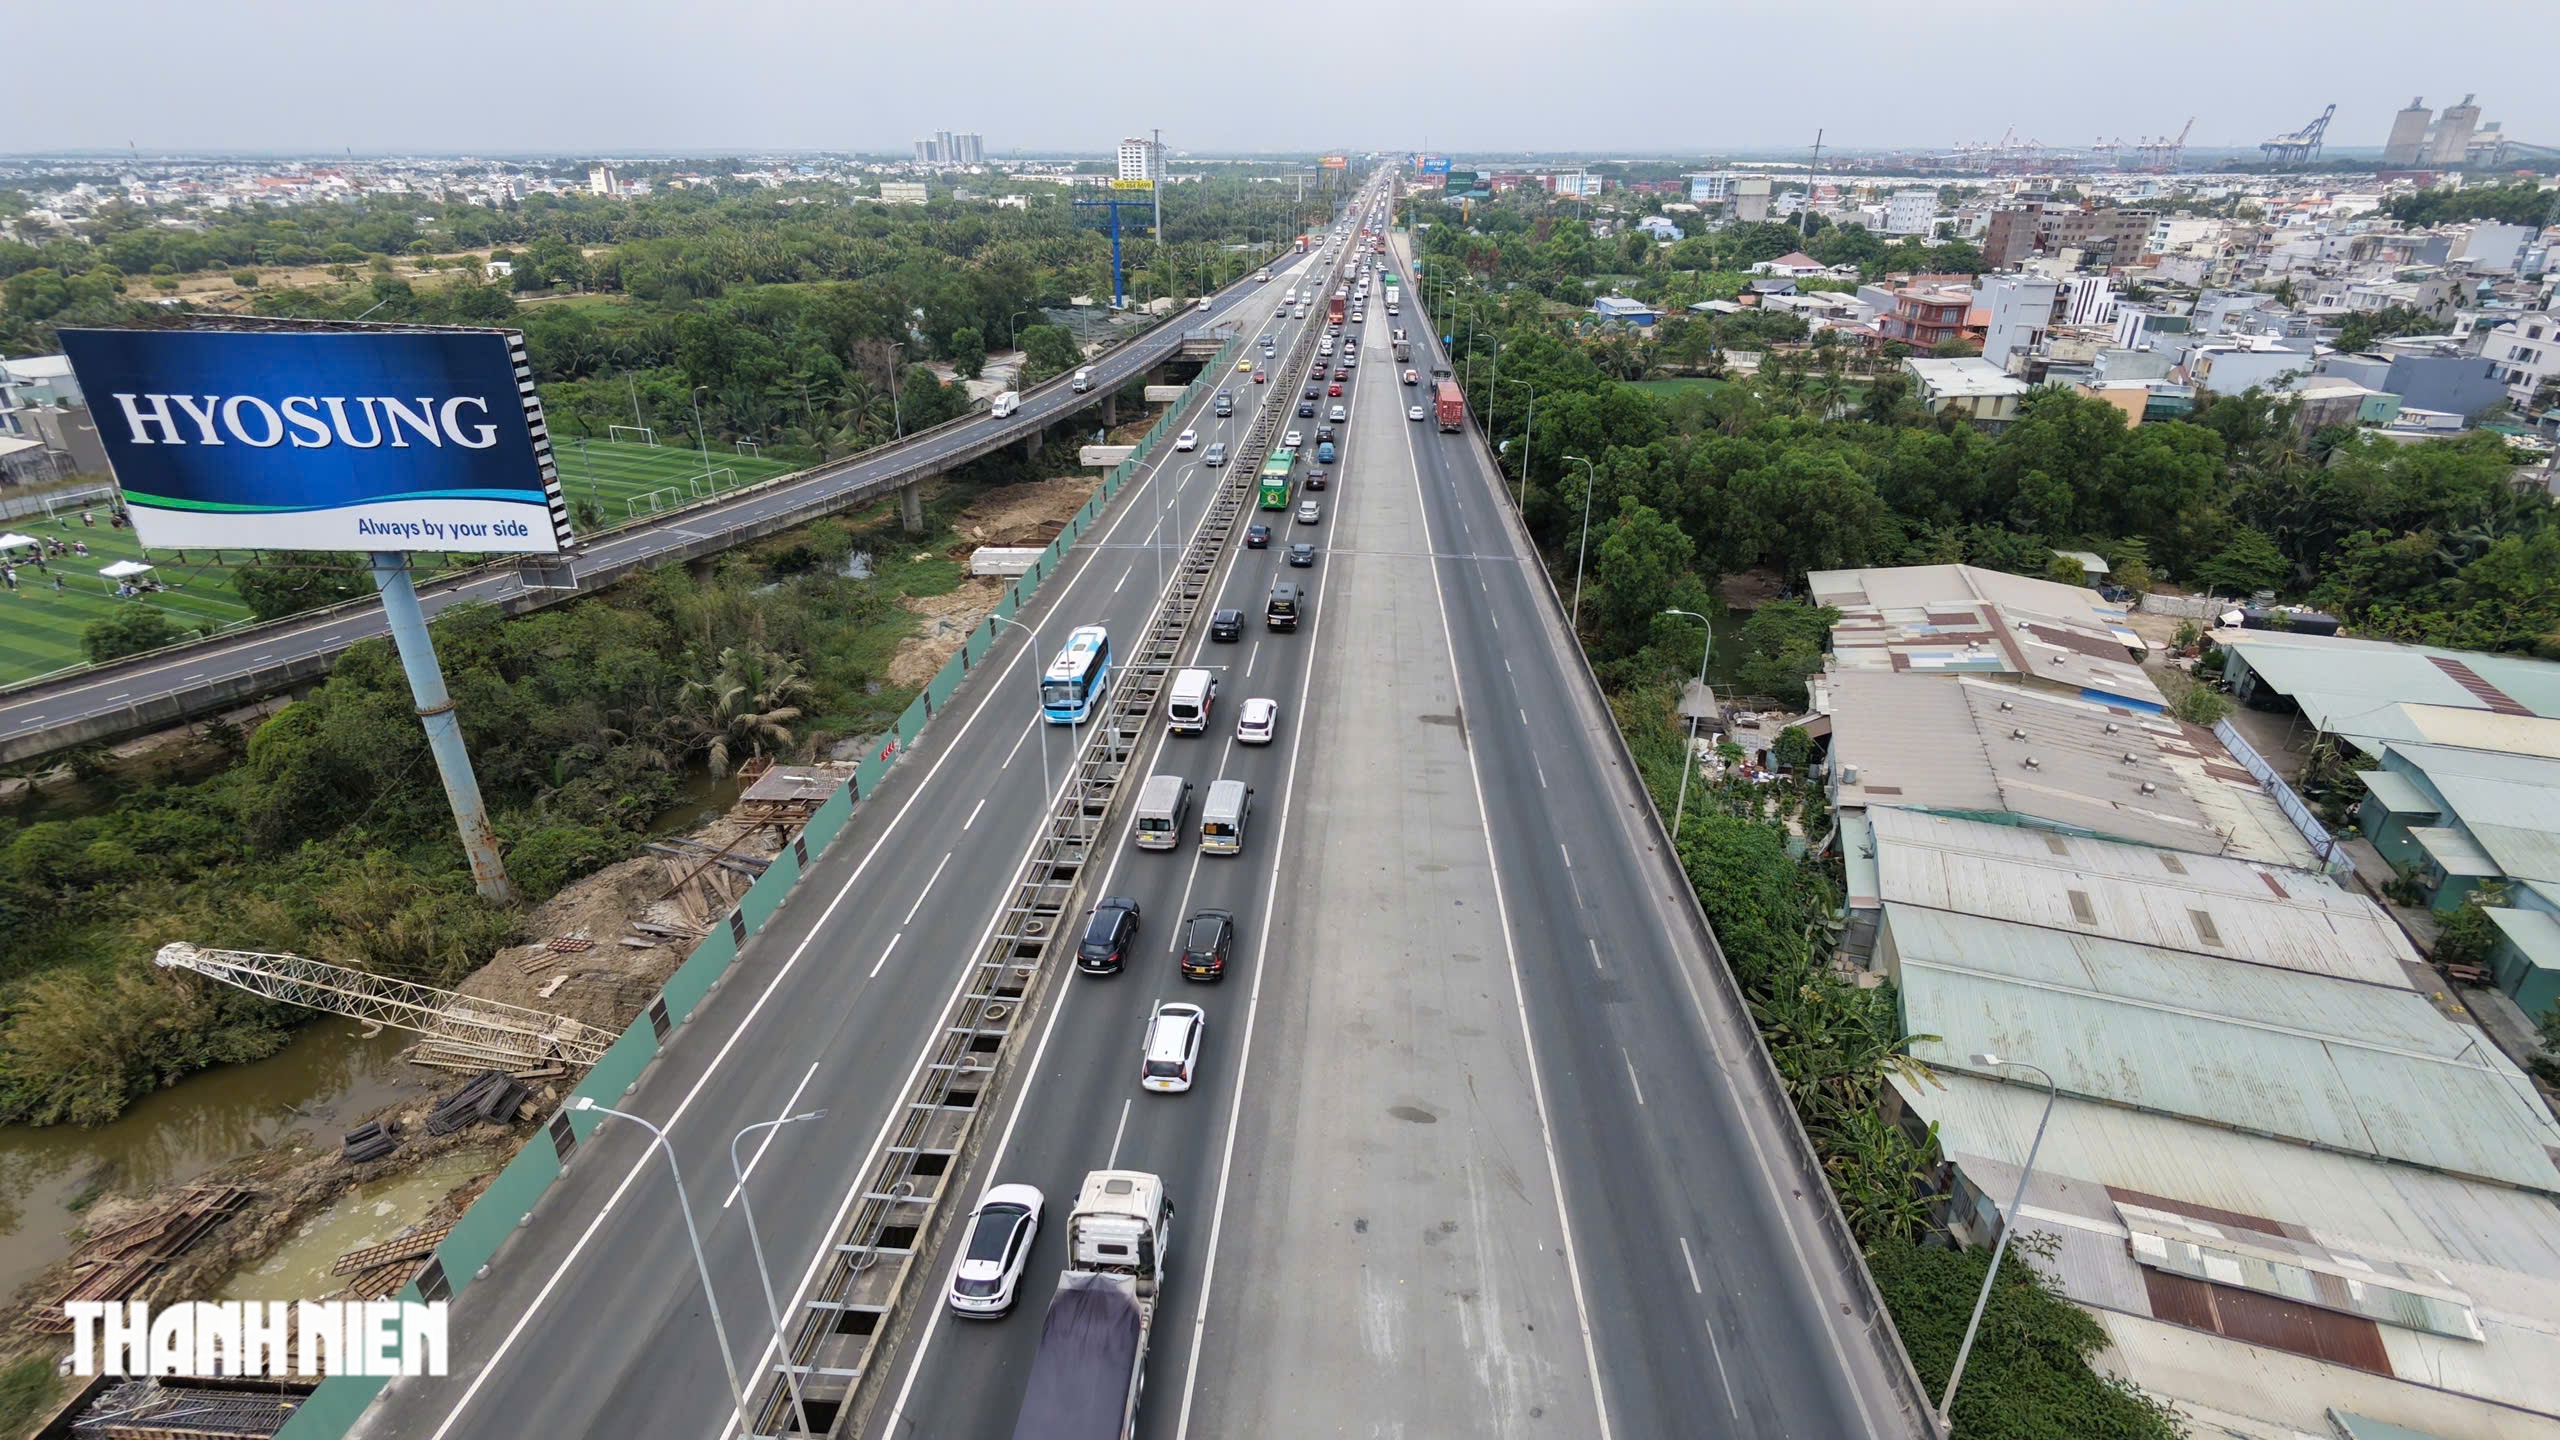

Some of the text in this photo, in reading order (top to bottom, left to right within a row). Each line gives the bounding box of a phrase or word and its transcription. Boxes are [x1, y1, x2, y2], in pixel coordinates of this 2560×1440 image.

[112, 392, 498, 449] HYOSUNG
[358, 518, 529, 540] Always by your side
